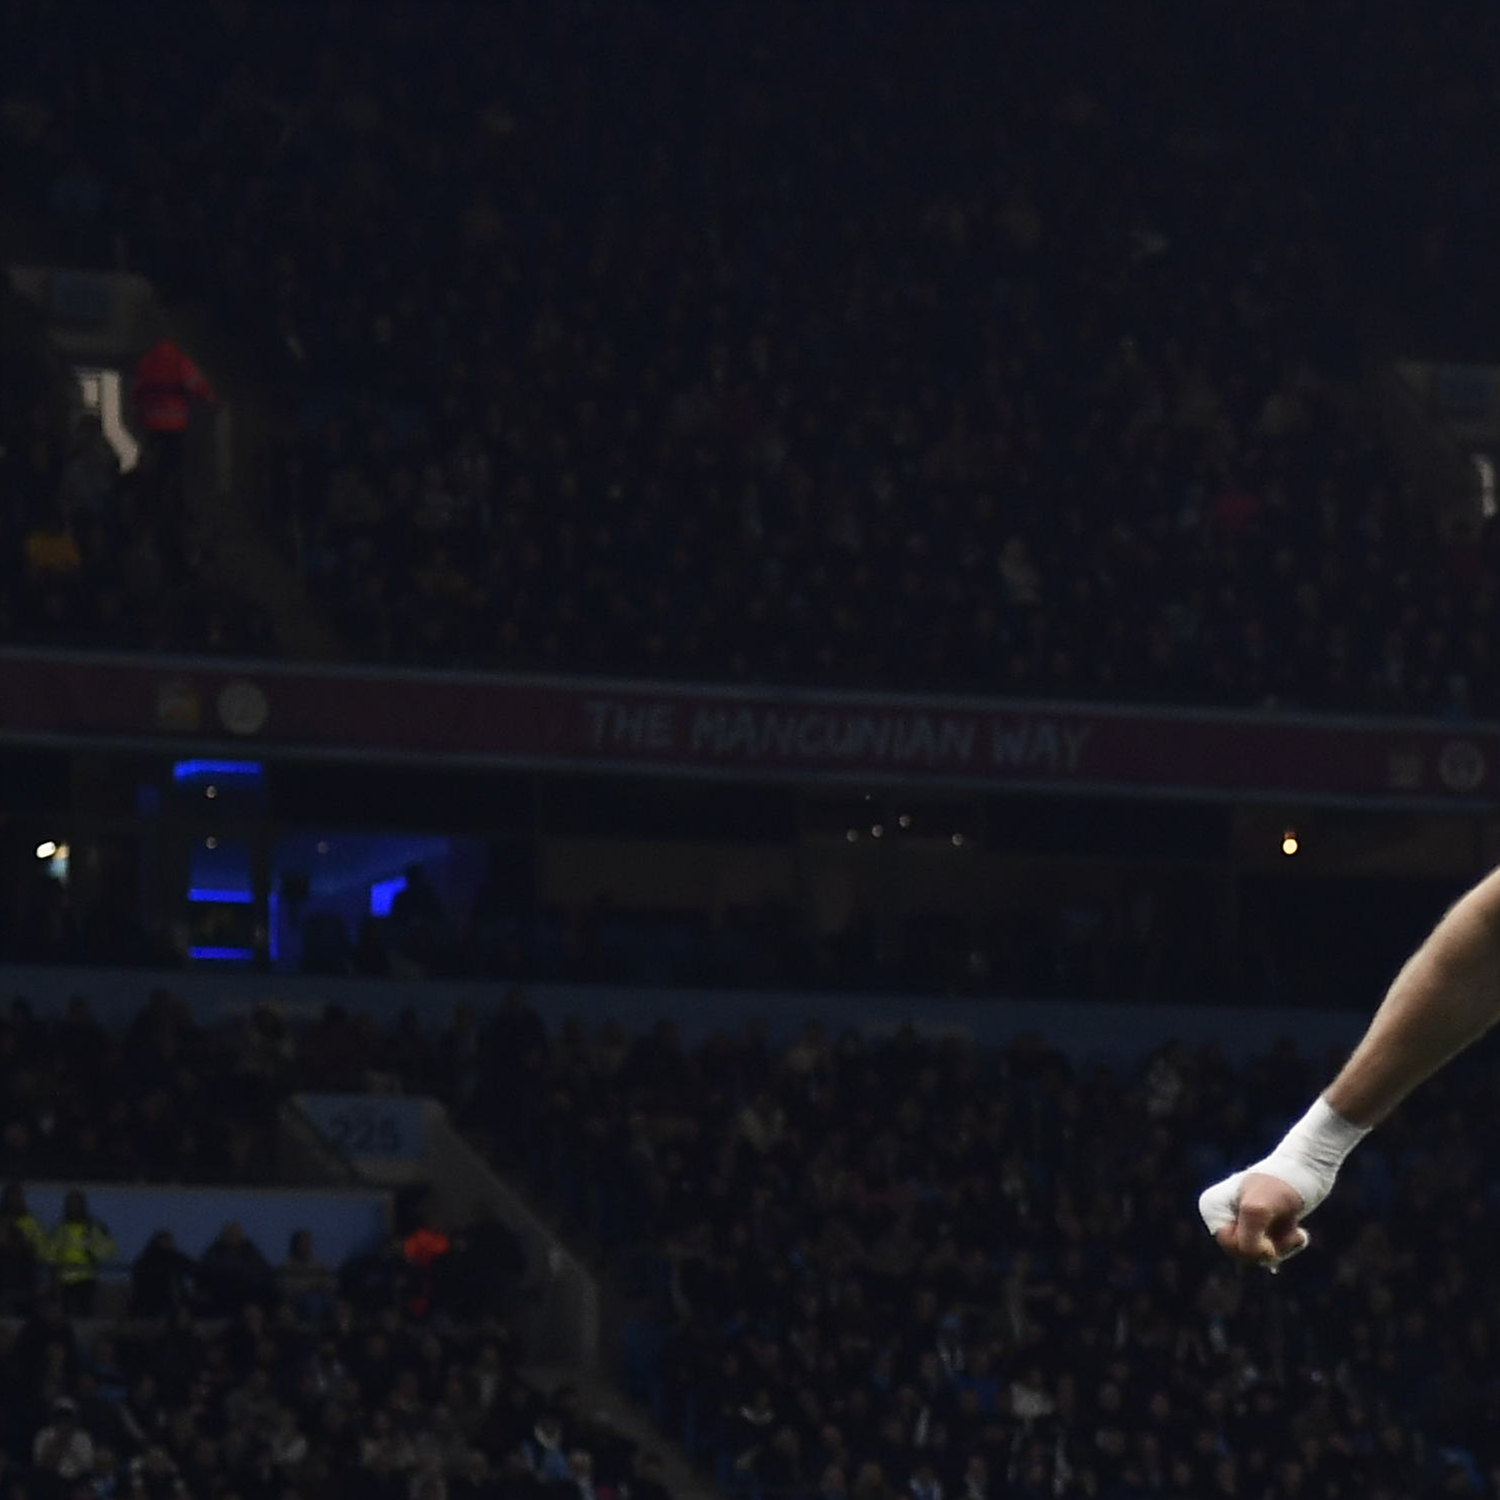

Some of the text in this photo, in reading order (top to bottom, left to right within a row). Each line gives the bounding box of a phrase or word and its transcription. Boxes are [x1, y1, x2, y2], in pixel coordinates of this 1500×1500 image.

[583, 698, 1093, 770] THE MANCUNIAN WAY
